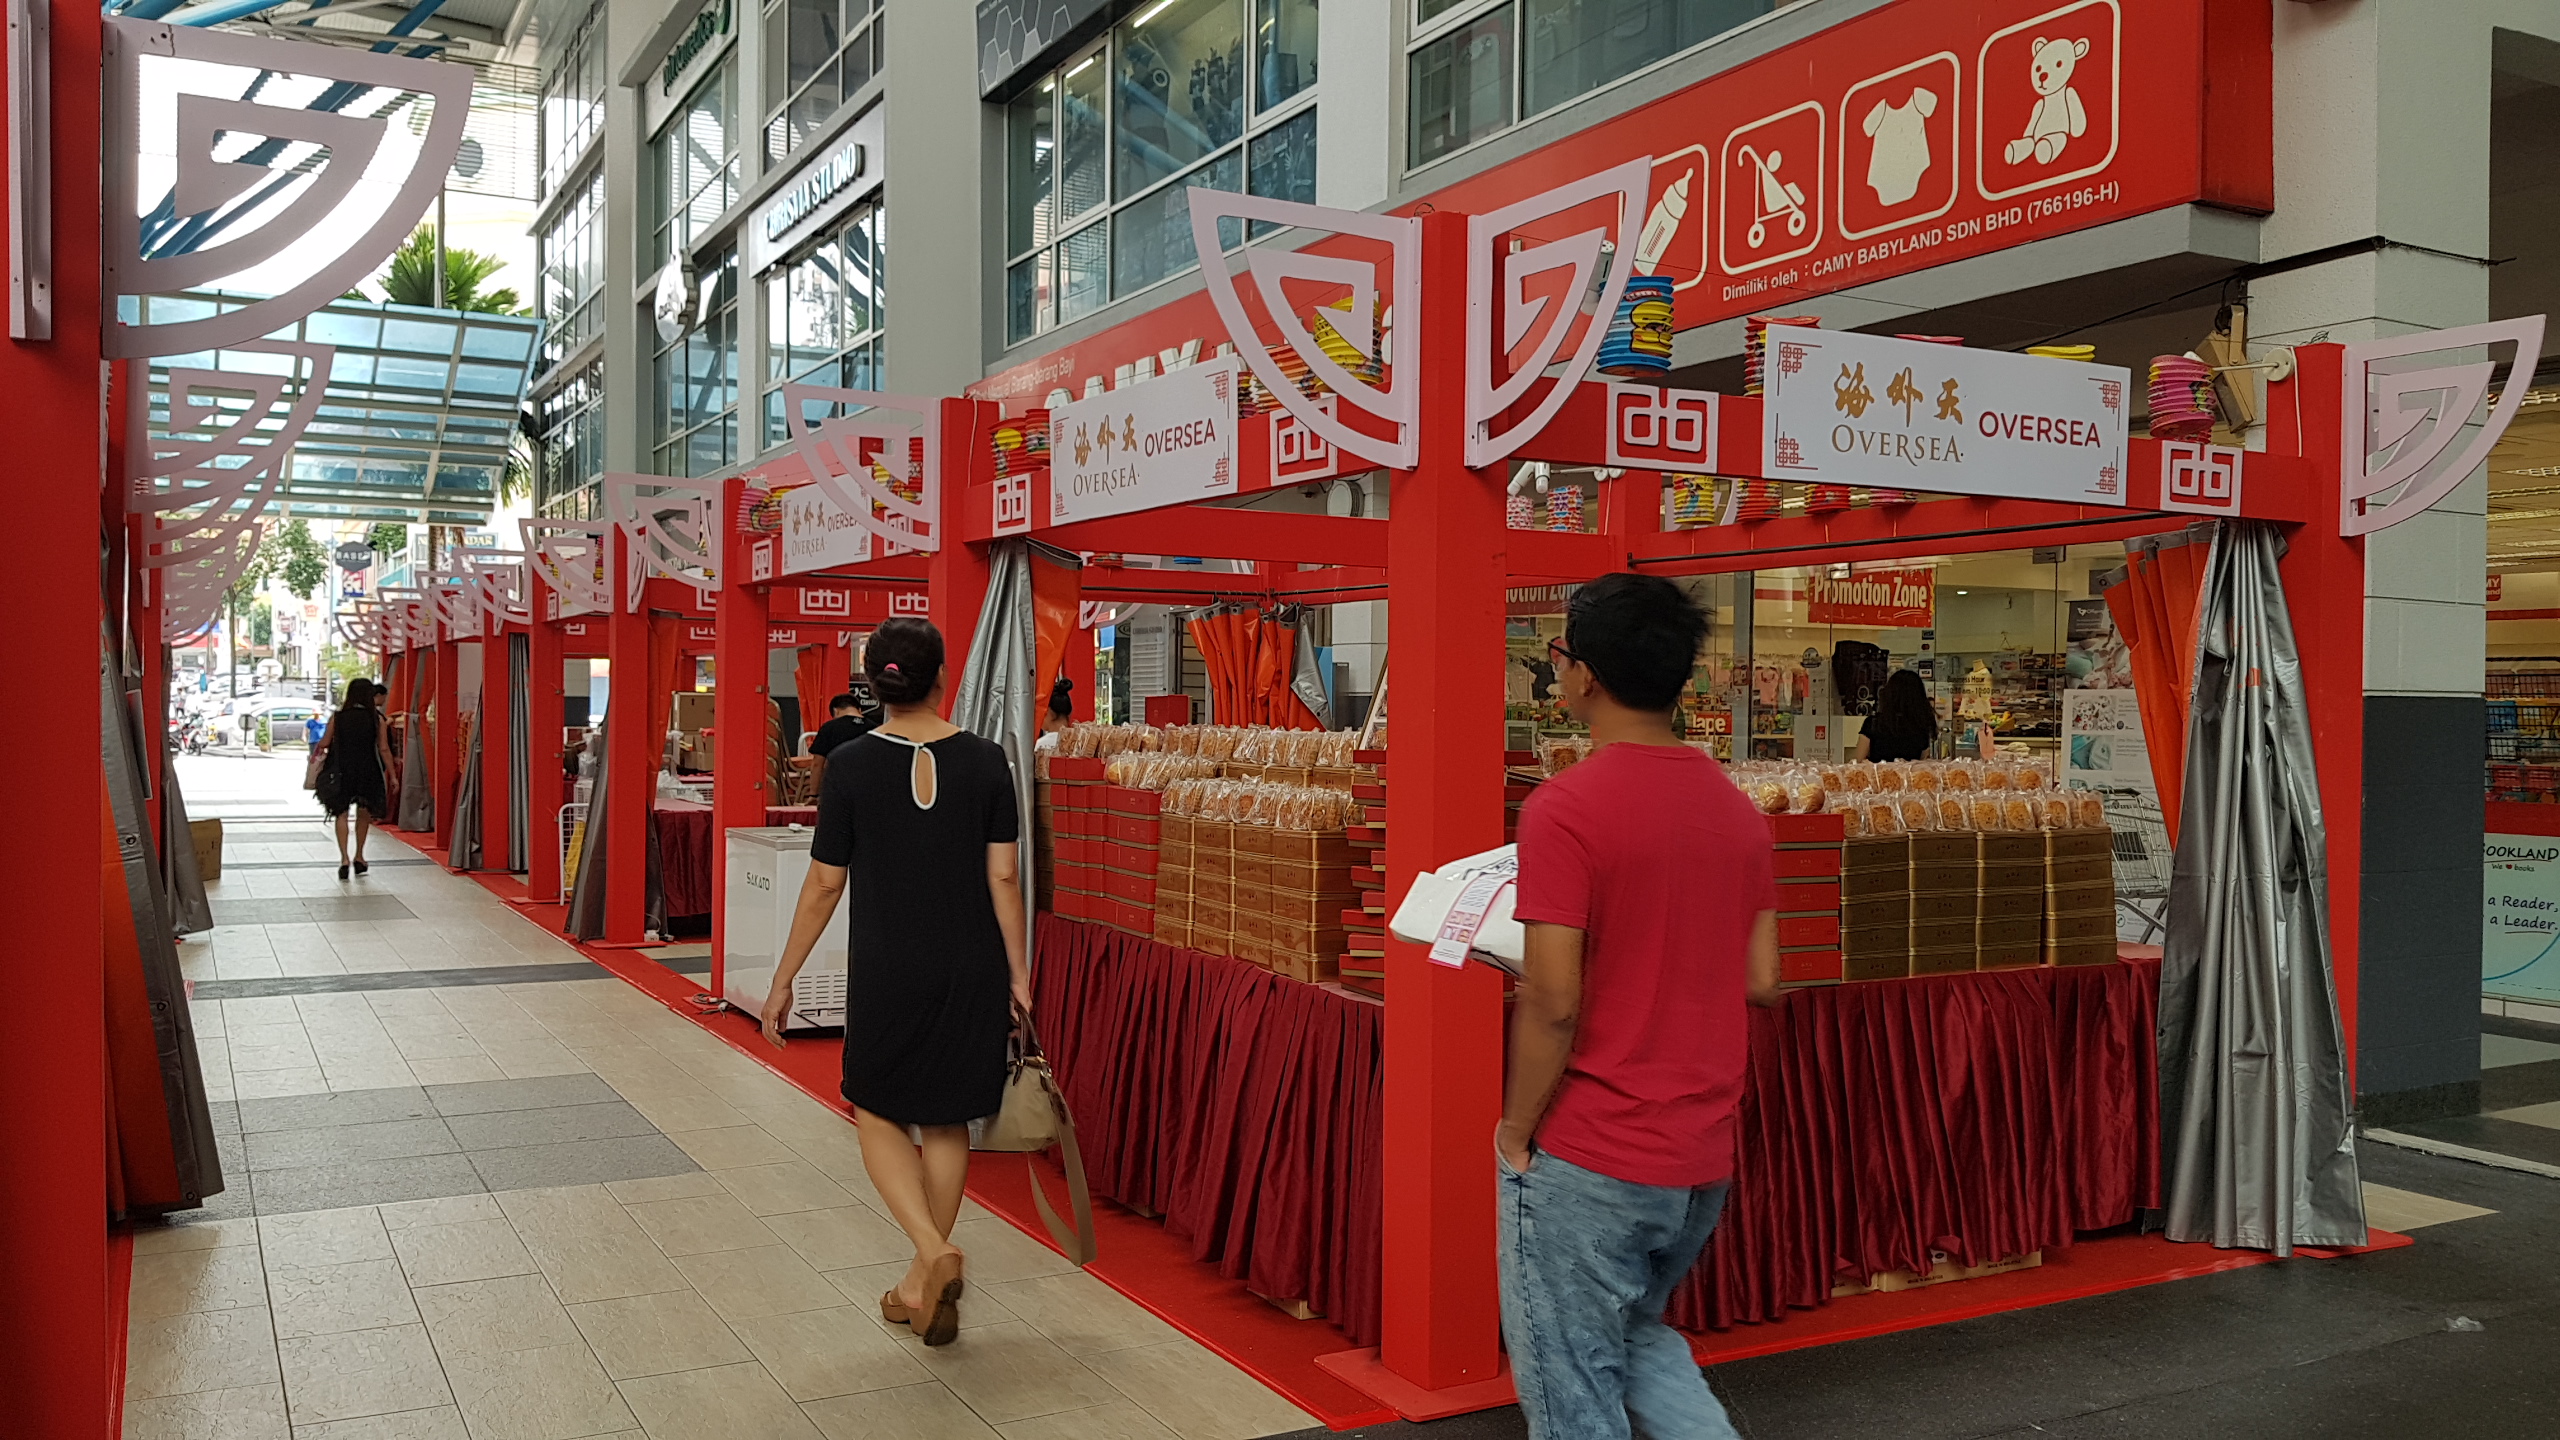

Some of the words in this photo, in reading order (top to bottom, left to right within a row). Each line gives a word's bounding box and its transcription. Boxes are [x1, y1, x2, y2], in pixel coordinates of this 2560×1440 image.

[1722, 278, 1768, 302] Dimiliki
[1771, 269, 1798, 289] oleh
[1812, 252, 1854, 277] CAMY
[1857, 228, 1942, 265] BABYLAND
[1946, 217, 1981, 243] SDN
[1985, 206, 2022, 232] BHD
[2027, 181, 2120, 224] (766196-H)
[1145, 418, 1216, 458] OVERSEA
[1978, 410, 2101, 448] OVERSEA
[1831, 423, 1963, 467] OVERSEA
[1073, 462, 1138, 497] OVERSEA
[827, 512, 858, 533] OVERSE
[791, 536, 825, 558] OVERSEA
[1505, 585, 1547, 603] otion
[1814, 572, 1891, 606] Promotion
[1892, 576, 1928, 608] Zone
[1991, 688, 2001, 696] pm
[2483, 843, 2560, 861] OOKLAND
[2514, 863, 2535, 872] books
[746, 871, 771, 891] SAKATO
[2487, 896, 2496, 906] a
[2502, 895, 2559, 913] Reader,
[2489, 915, 2498, 925] a
[2504, 914, 2559, 931] Leader.
